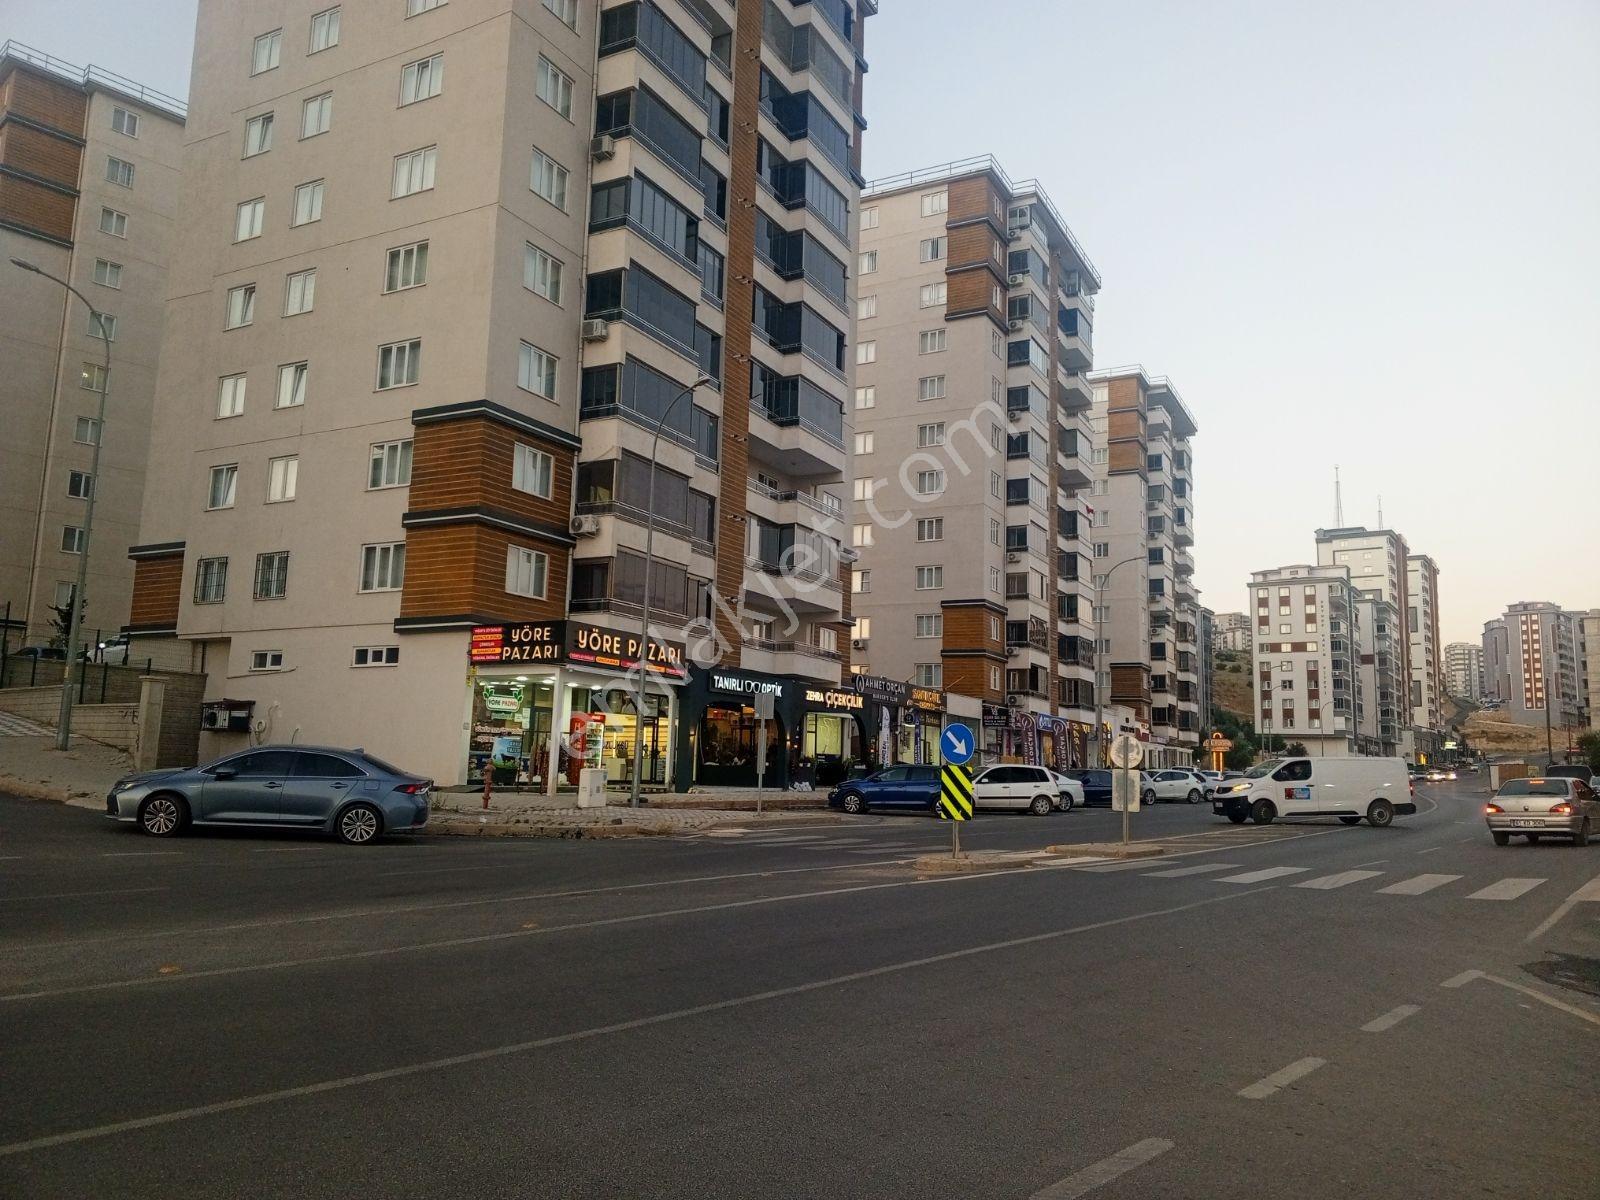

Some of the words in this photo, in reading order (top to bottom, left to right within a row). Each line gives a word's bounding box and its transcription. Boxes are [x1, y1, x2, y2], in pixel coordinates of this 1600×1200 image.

[511, 625, 552, 643] YÖRE
[578, 628, 621, 655] YÖRE
[502, 645, 558, 660] PAZARI
[713, 675, 744, 692] TANIRLI
[761, 682, 783, 697] OPTİK
[865, 678, 885, 691] AHMET
[886, 682, 906, 695] ORÇAN
[805, 690, 824, 702] ZEHRA
[825, 690, 864, 710] ÇİÇEKÇİLİK
